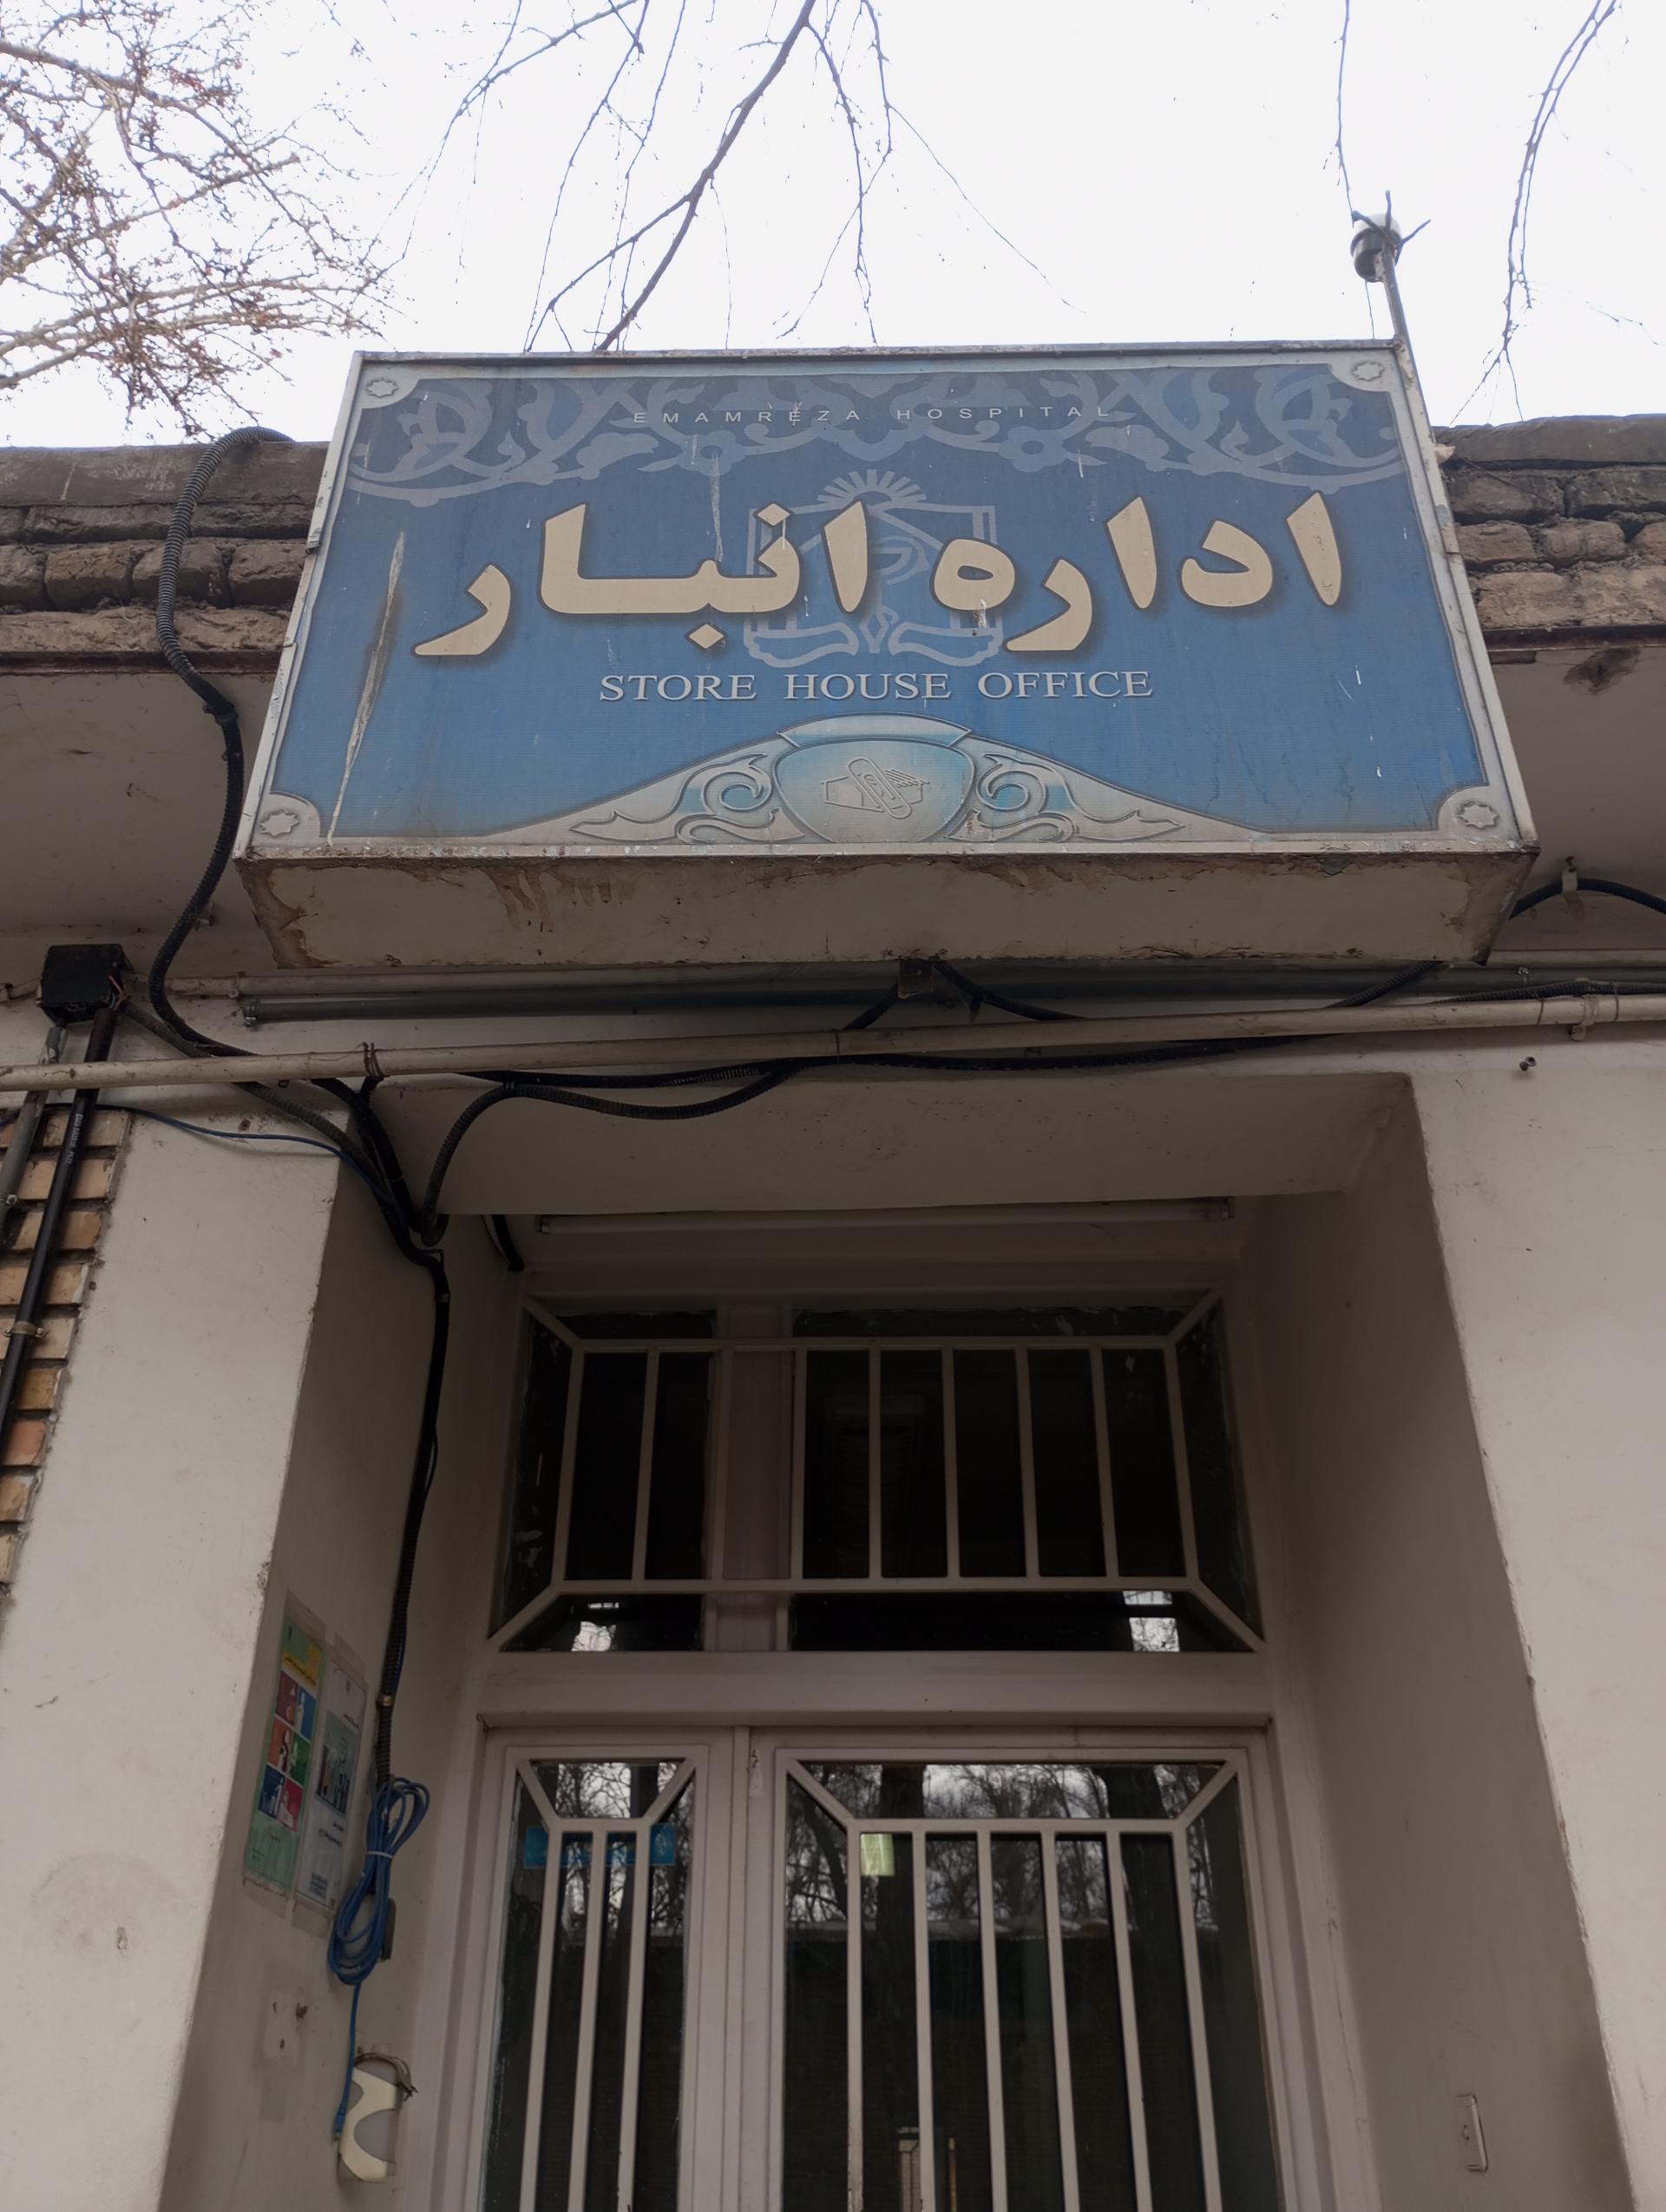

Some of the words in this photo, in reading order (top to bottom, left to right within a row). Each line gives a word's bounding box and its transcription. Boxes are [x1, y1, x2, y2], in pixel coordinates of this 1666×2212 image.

[633, 409, 861, 425] EMAMREZA
[896, 405, 1110, 420] HOSPITAL
[411, 501, 869, 658] انبار
[932, 490, 1344, 653] اداره
[599, 674, 758, 701] STORE
[783, 672, 953, 701] HOUSE
[977, 671, 1155, 699] OFFICE
